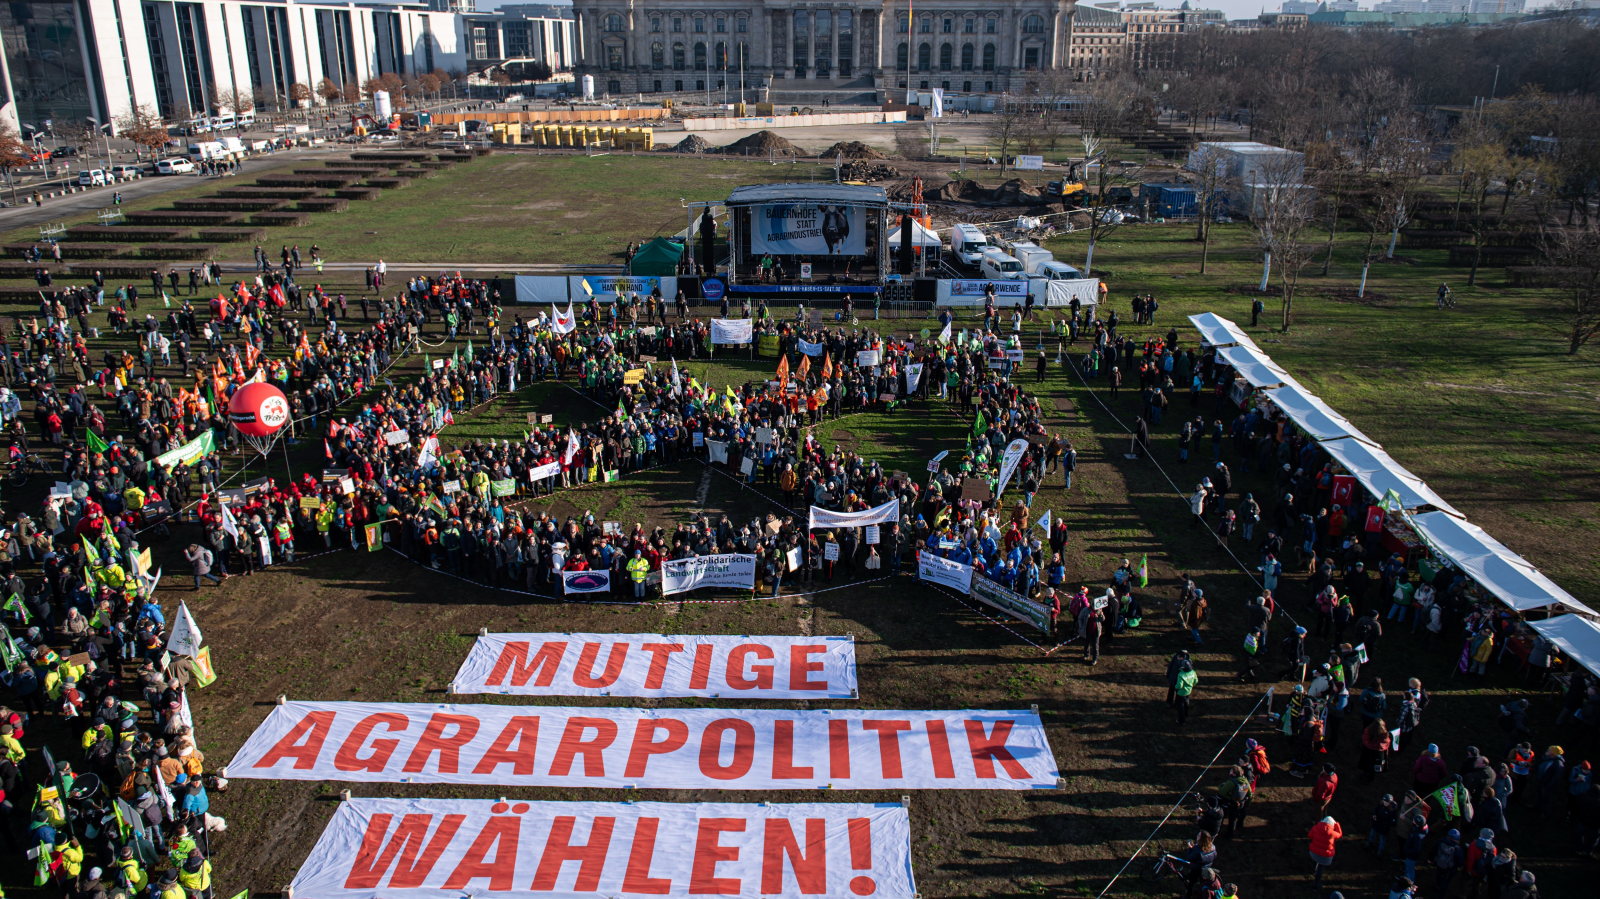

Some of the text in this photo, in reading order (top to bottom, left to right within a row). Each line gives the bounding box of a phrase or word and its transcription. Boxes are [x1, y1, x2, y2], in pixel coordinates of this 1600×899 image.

[766, 206, 817, 219] BAUERNHÖFE
[797, 220, 816, 229] STATT
[767, 230, 823, 242] AGRARINDUSTRIE!
[602, 284, 618, 292] HAND
[626, 284, 643, 292] HAND
[697, 555, 752, 566] Solidarische
[665, 564, 729, 578] Landwirtschaft
[485, 641, 828, 690] MUTIGE
[252, 710, 1033, 780] AGRARPOLITIK
[343, 802, 877, 897] WÄHLEN!
